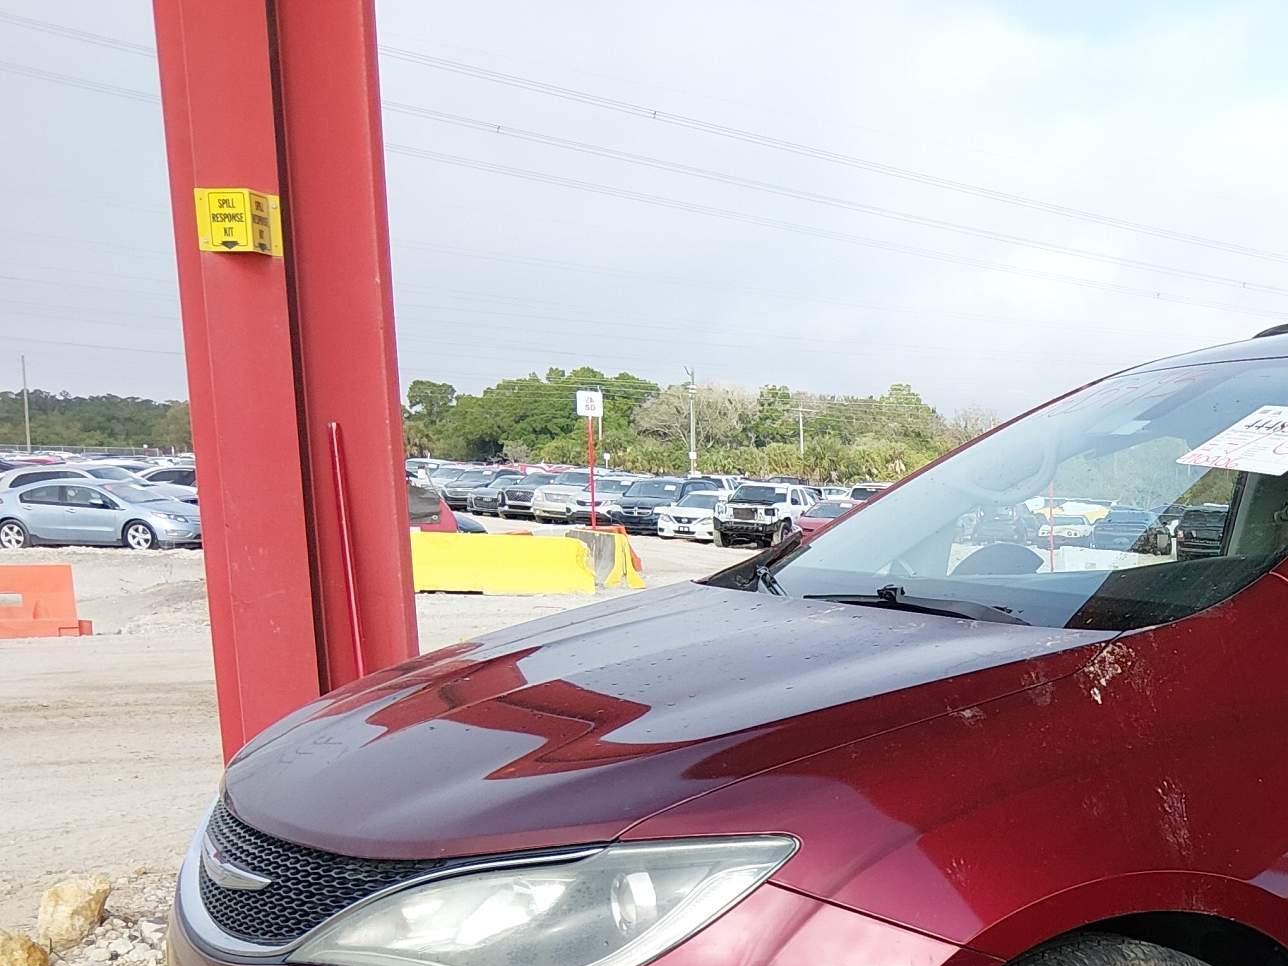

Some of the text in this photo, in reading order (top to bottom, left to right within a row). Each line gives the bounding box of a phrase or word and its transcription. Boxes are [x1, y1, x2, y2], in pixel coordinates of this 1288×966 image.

[217, 198, 236, 208] SPILL
[211, 212, 245, 223] RESPONSE
[223, 227, 234, 237] KIT
